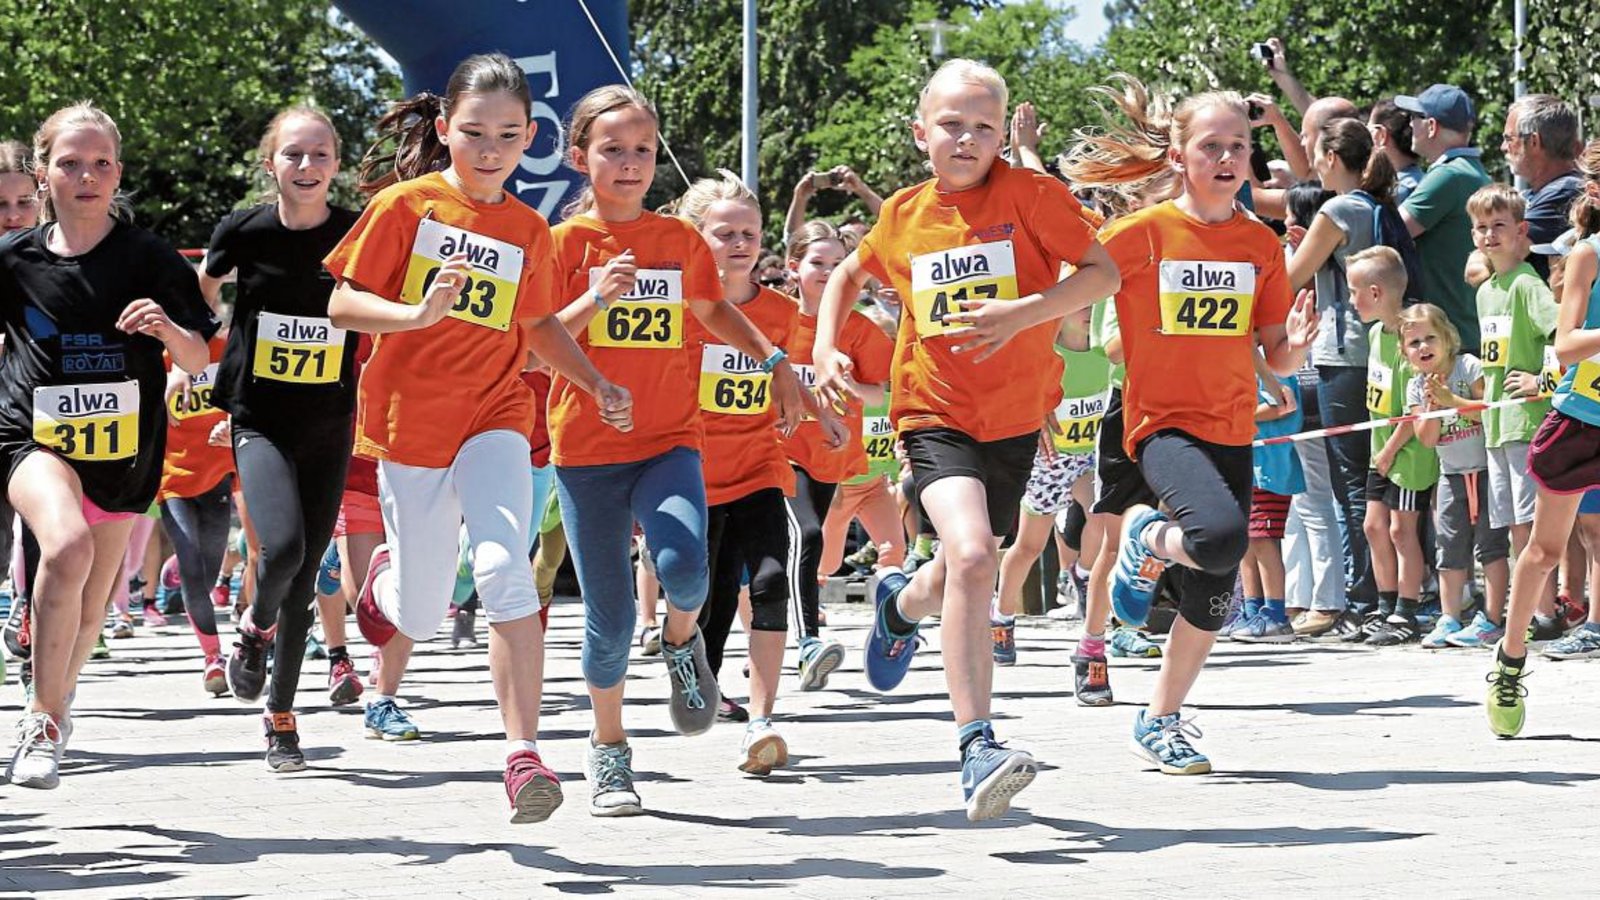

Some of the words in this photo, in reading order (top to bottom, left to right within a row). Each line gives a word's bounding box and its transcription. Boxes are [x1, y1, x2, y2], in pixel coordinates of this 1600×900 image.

[439, 233, 500, 271] alwa
[931, 252, 990, 281] alwa
[1181, 263, 1236, 288] alwa
[607, 306, 672, 342] 623
[1176, 296, 1239, 330] 422
[277, 318, 329, 341] alwa
[269, 346, 327, 378] 571
[722, 352, 765, 371] alw
[58, 388, 120, 414] alwa
[714, 378, 767, 409] 634
[1069, 399, 1103, 416] alwa
[53, 420, 120, 455] 311
